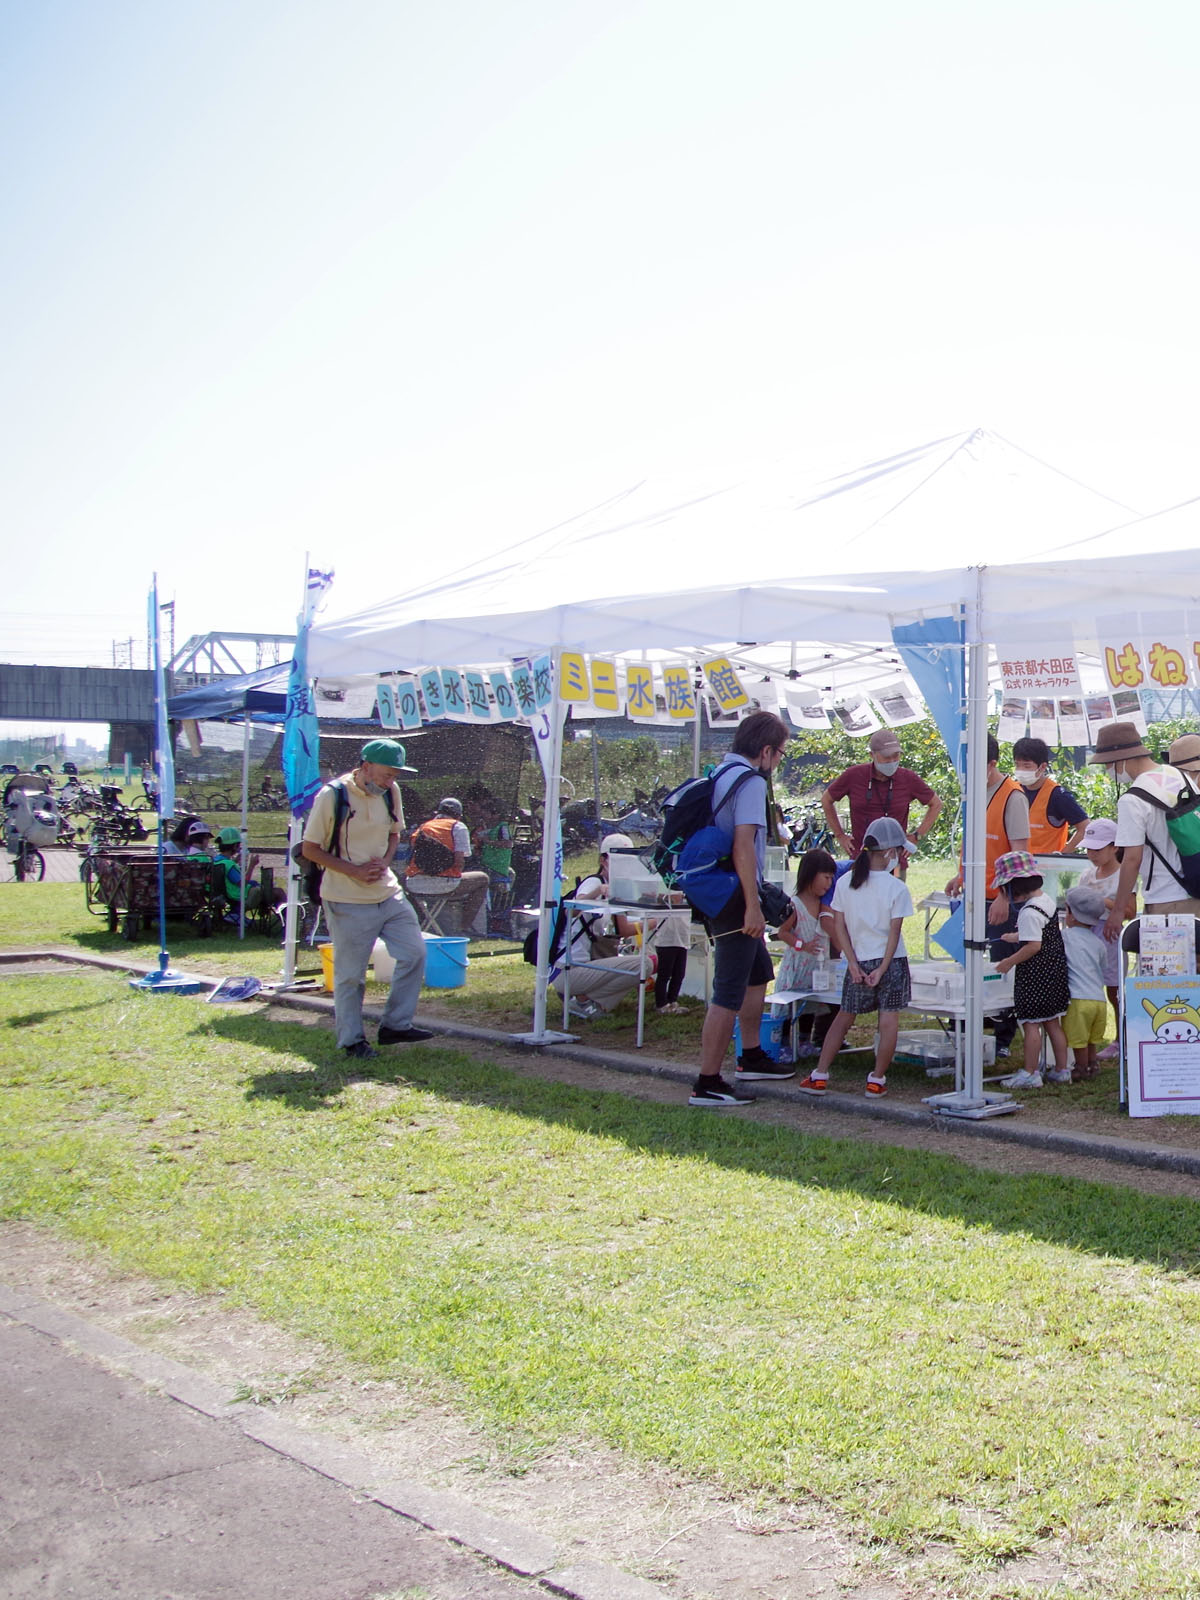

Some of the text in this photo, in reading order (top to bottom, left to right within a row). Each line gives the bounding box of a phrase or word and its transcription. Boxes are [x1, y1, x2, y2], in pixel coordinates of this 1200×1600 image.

[381, 661, 550, 718] うのき水辺の楽校
[567, 663, 742, 711] ミニ水族館
[1002, 657, 1076, 676] 東京都大田区
